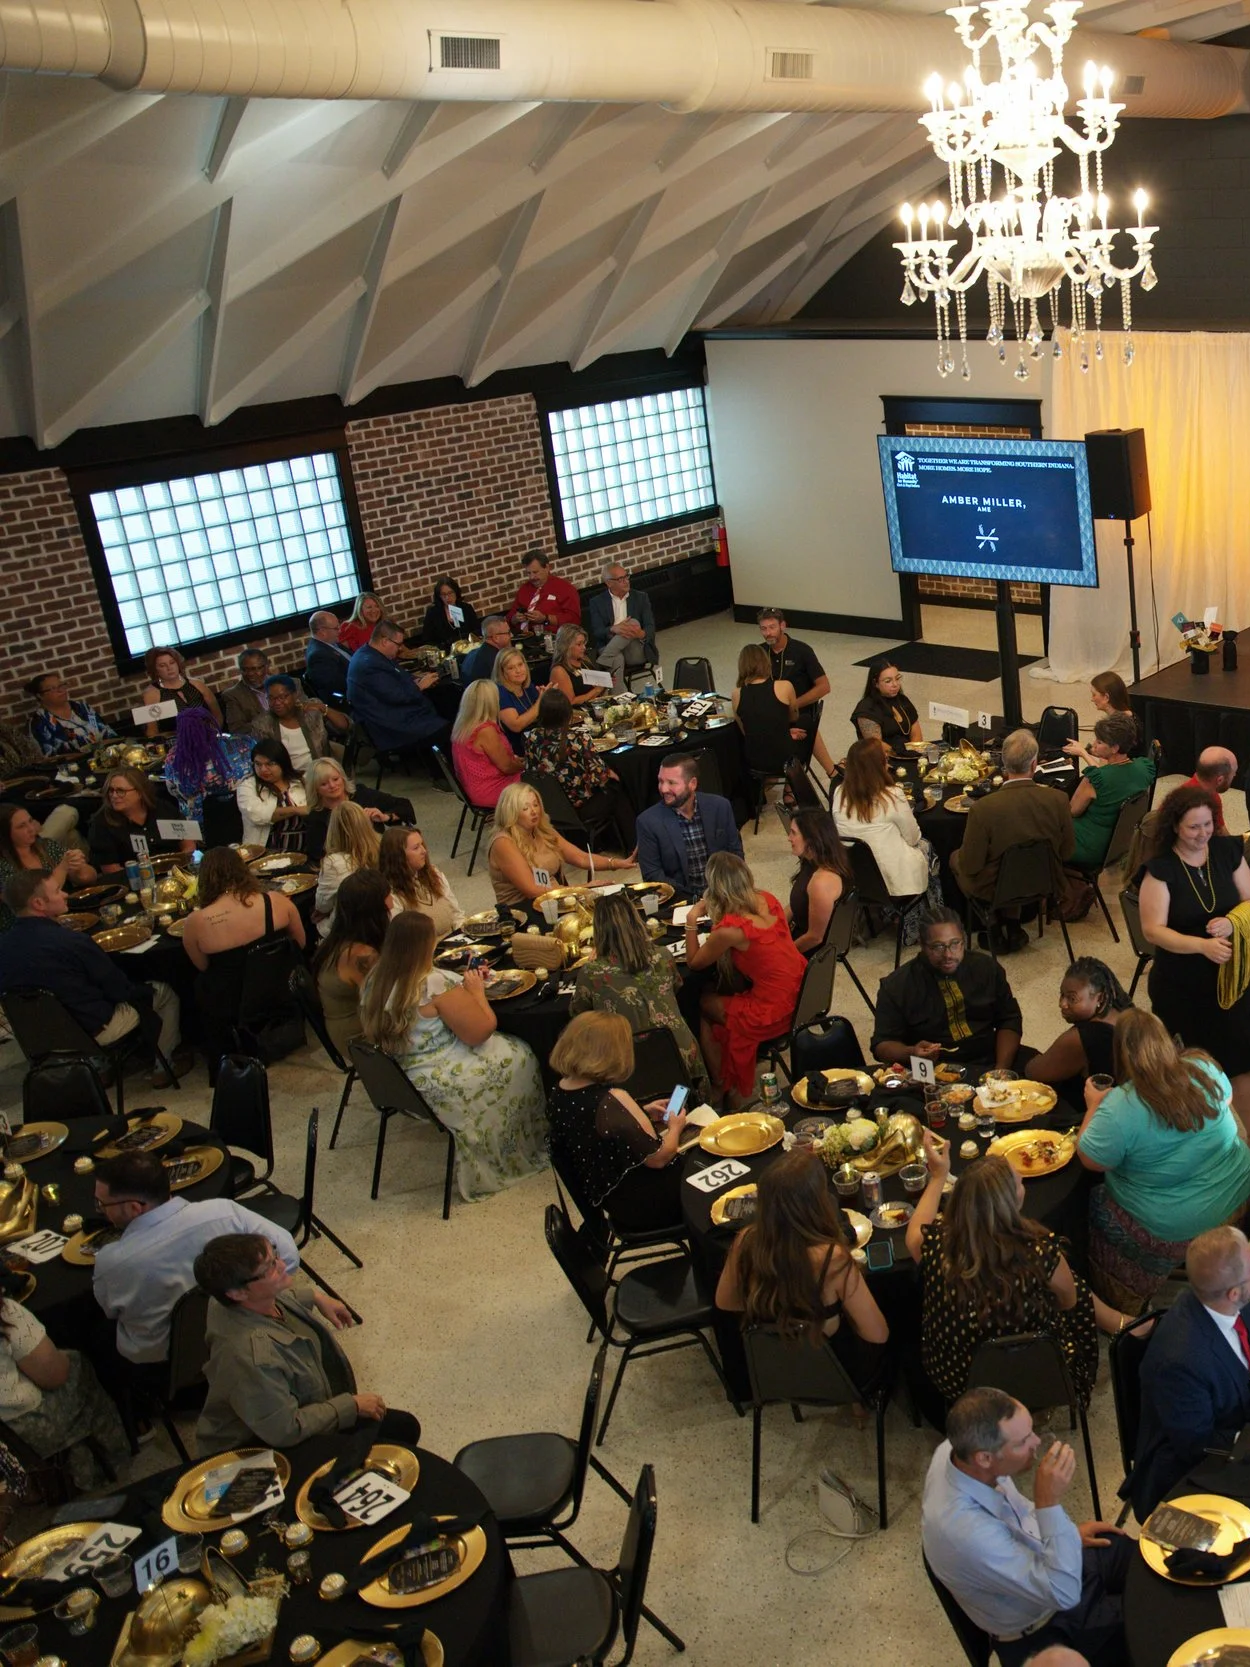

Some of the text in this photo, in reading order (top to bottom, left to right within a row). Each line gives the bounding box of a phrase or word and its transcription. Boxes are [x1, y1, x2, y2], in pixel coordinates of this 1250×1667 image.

[942, 495, 1026, 509] AMBER MILLER,
[981, 714, 987, 726] 3
[134, 838, 146, 848] 11
[535, 871, 548, 884] 10
[918, 1061, 928, 1078] 9
[698, 1162, 743, 1189] 262
[354, 1482, 397, 1520] 264
[63, 1531, 133, 1580] 259
[139, 1547, 172, 1582] 16
